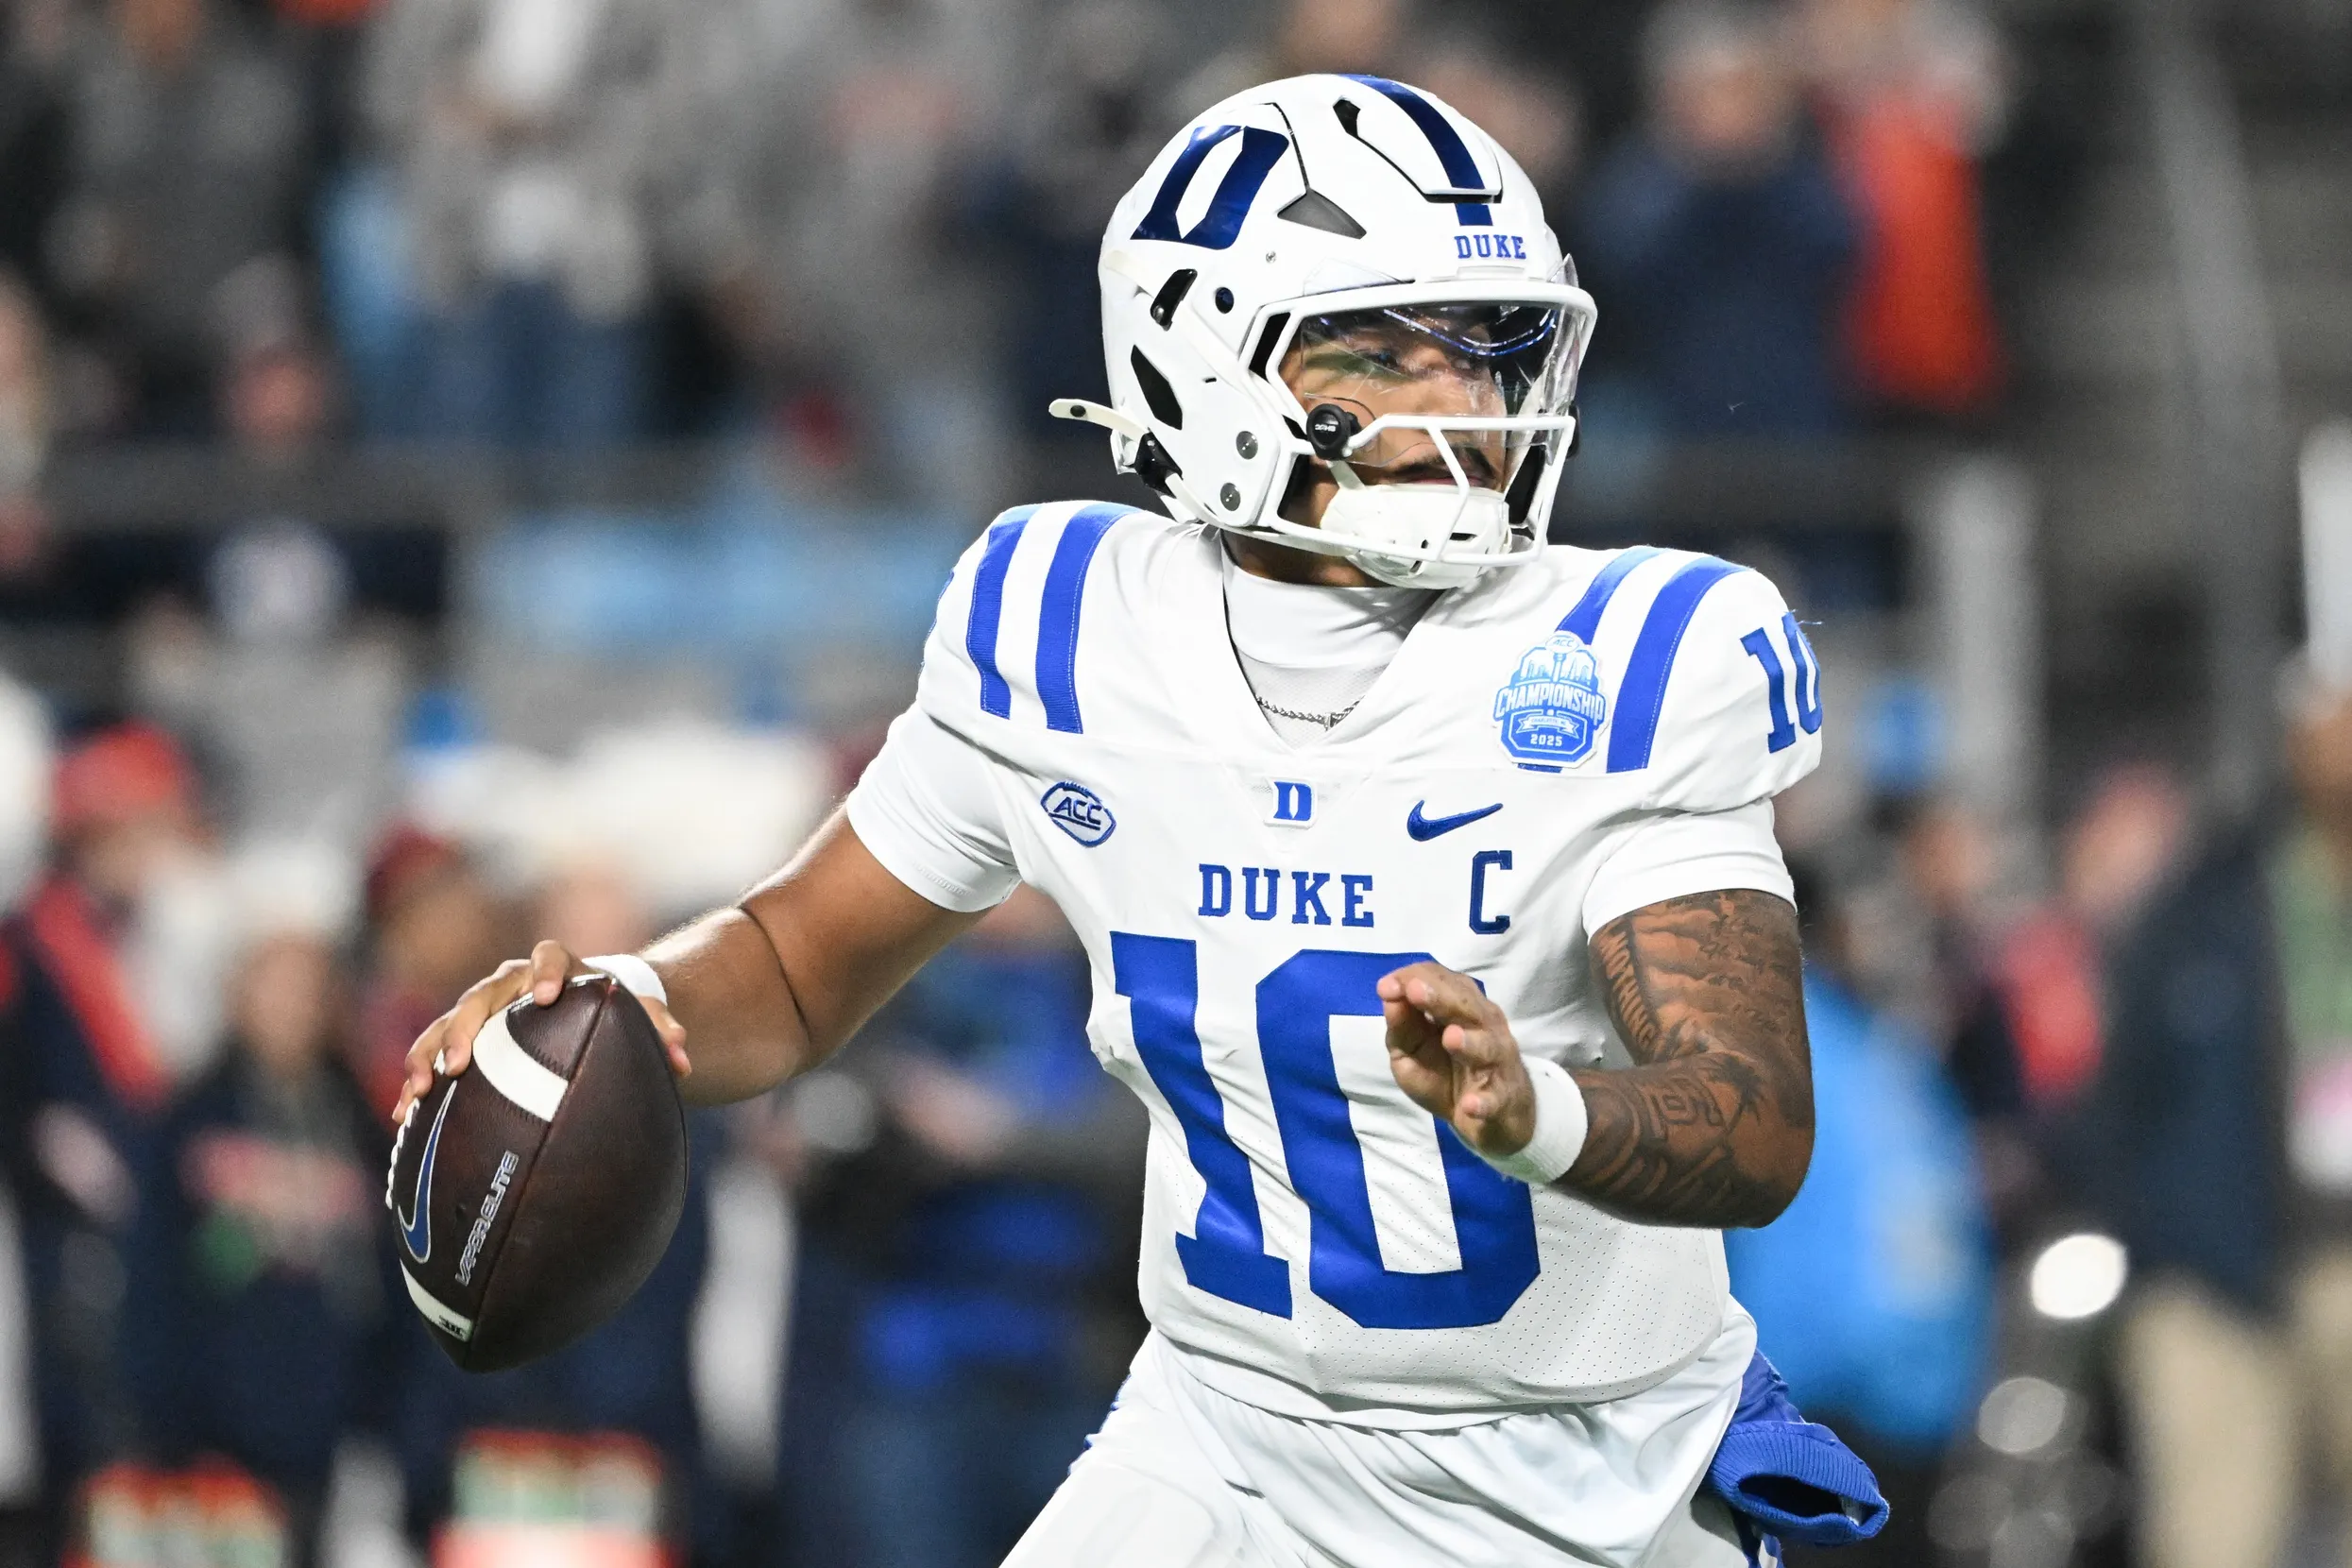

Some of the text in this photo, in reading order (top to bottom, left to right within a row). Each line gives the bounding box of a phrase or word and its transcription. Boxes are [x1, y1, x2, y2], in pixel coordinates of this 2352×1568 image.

[1130, 125, 1289, 250] D
[1454, 234, 1527, 261] DUKE
[1552, 639, 1575, 648] ACC
[1494, 682, 1605, 726] CHAMPIONSHIP
[1740, 612, 1823, 754] 10
[1530, 733, 1563, 747] 2025
[1050, 795, 1103, 828] ACC
[1272, 780, 1315, 822] D
[1198, 863, 1375, 929] DUKE
[1469, 850, 1513, 935] C
[1110, 930, 1542, 1330] 10
[480, 1150, 519, 1222] ELITE
